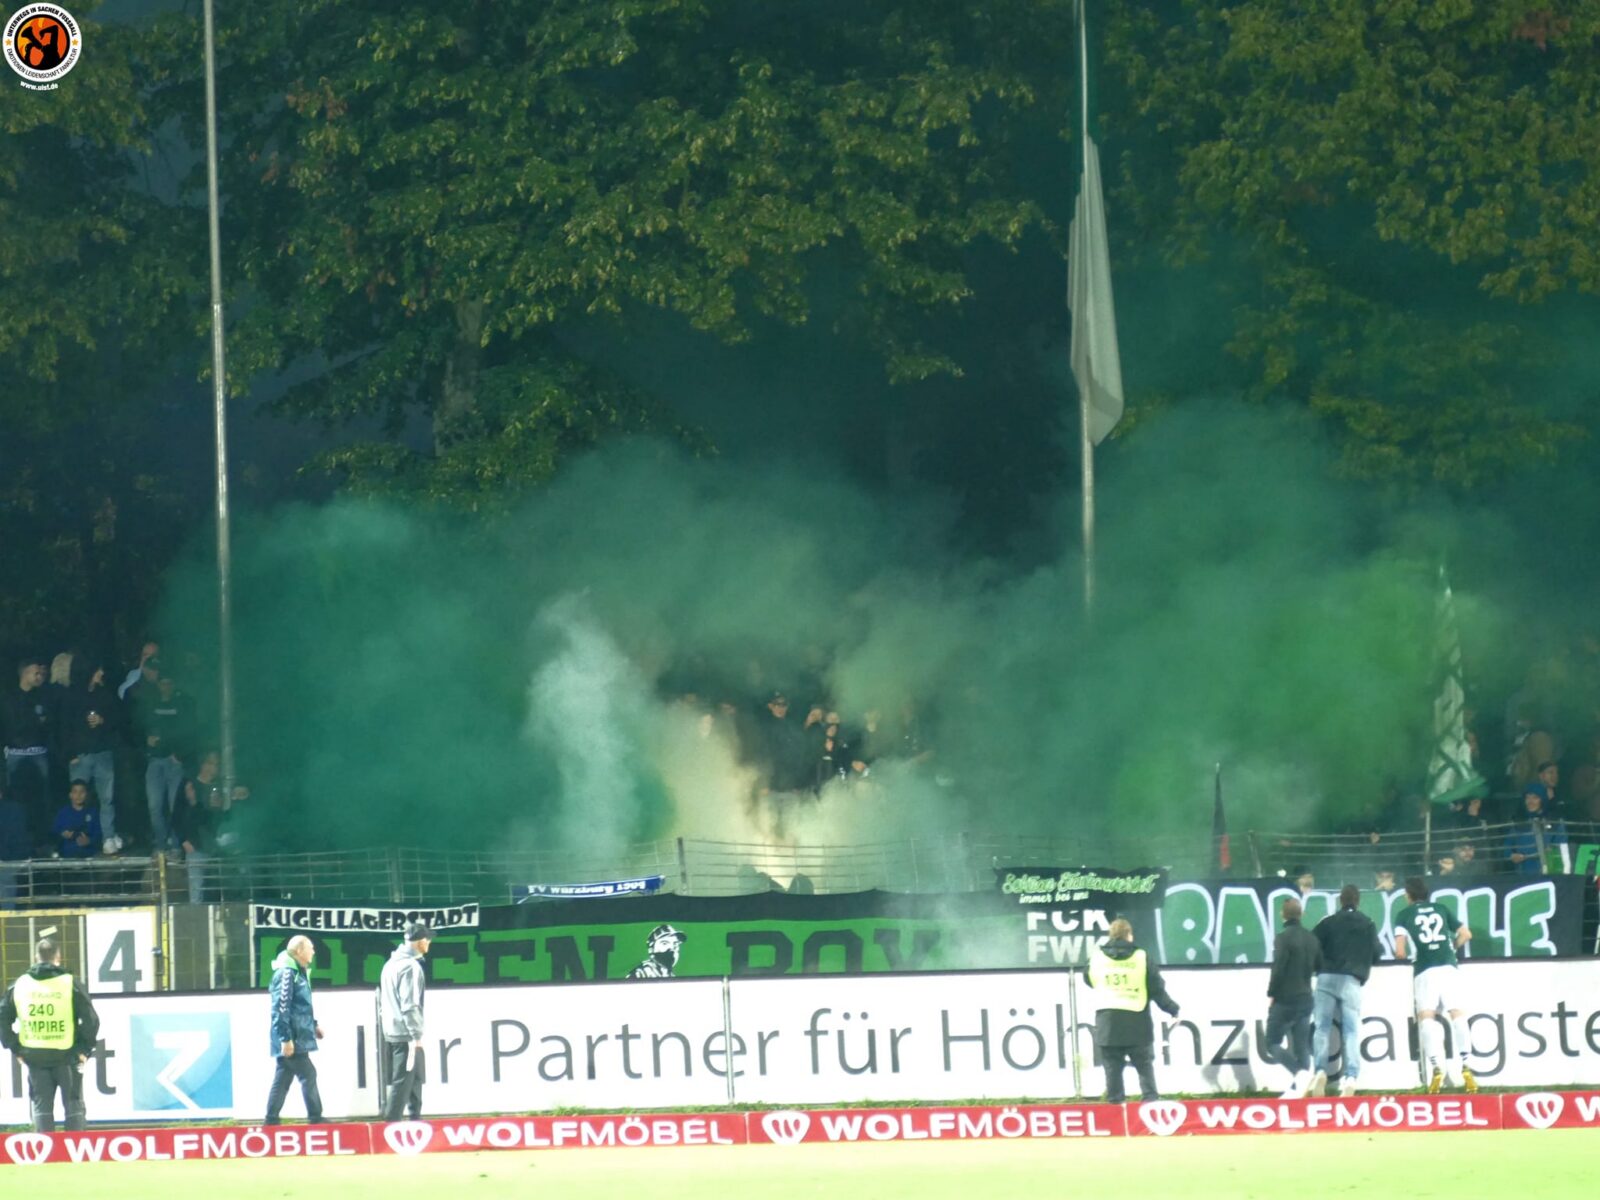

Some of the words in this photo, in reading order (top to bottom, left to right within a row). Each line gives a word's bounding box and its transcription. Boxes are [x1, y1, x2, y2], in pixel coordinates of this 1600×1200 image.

[255, 904, 478, 931] KUGELLAGERSTADT
[1414, 913, 1447, 943] 32
[97, 930, 142, 993] 4
[1105, 973, 1128, 986] 131
[28, 1003, 54, 1016] 240
[490, 1019, 780, 1083] Partner
[804, 1007, 912, 1075] für
[820, 1108, 1111, 1141] WOLFMÖBEL
[1196, 1096, 1488, 1129] WOLFMÖBEL
[64, 1128, 356, 1163] WOLFMÖBEL
[442, 1117, 734, 1149] WOLFMÖBEL
